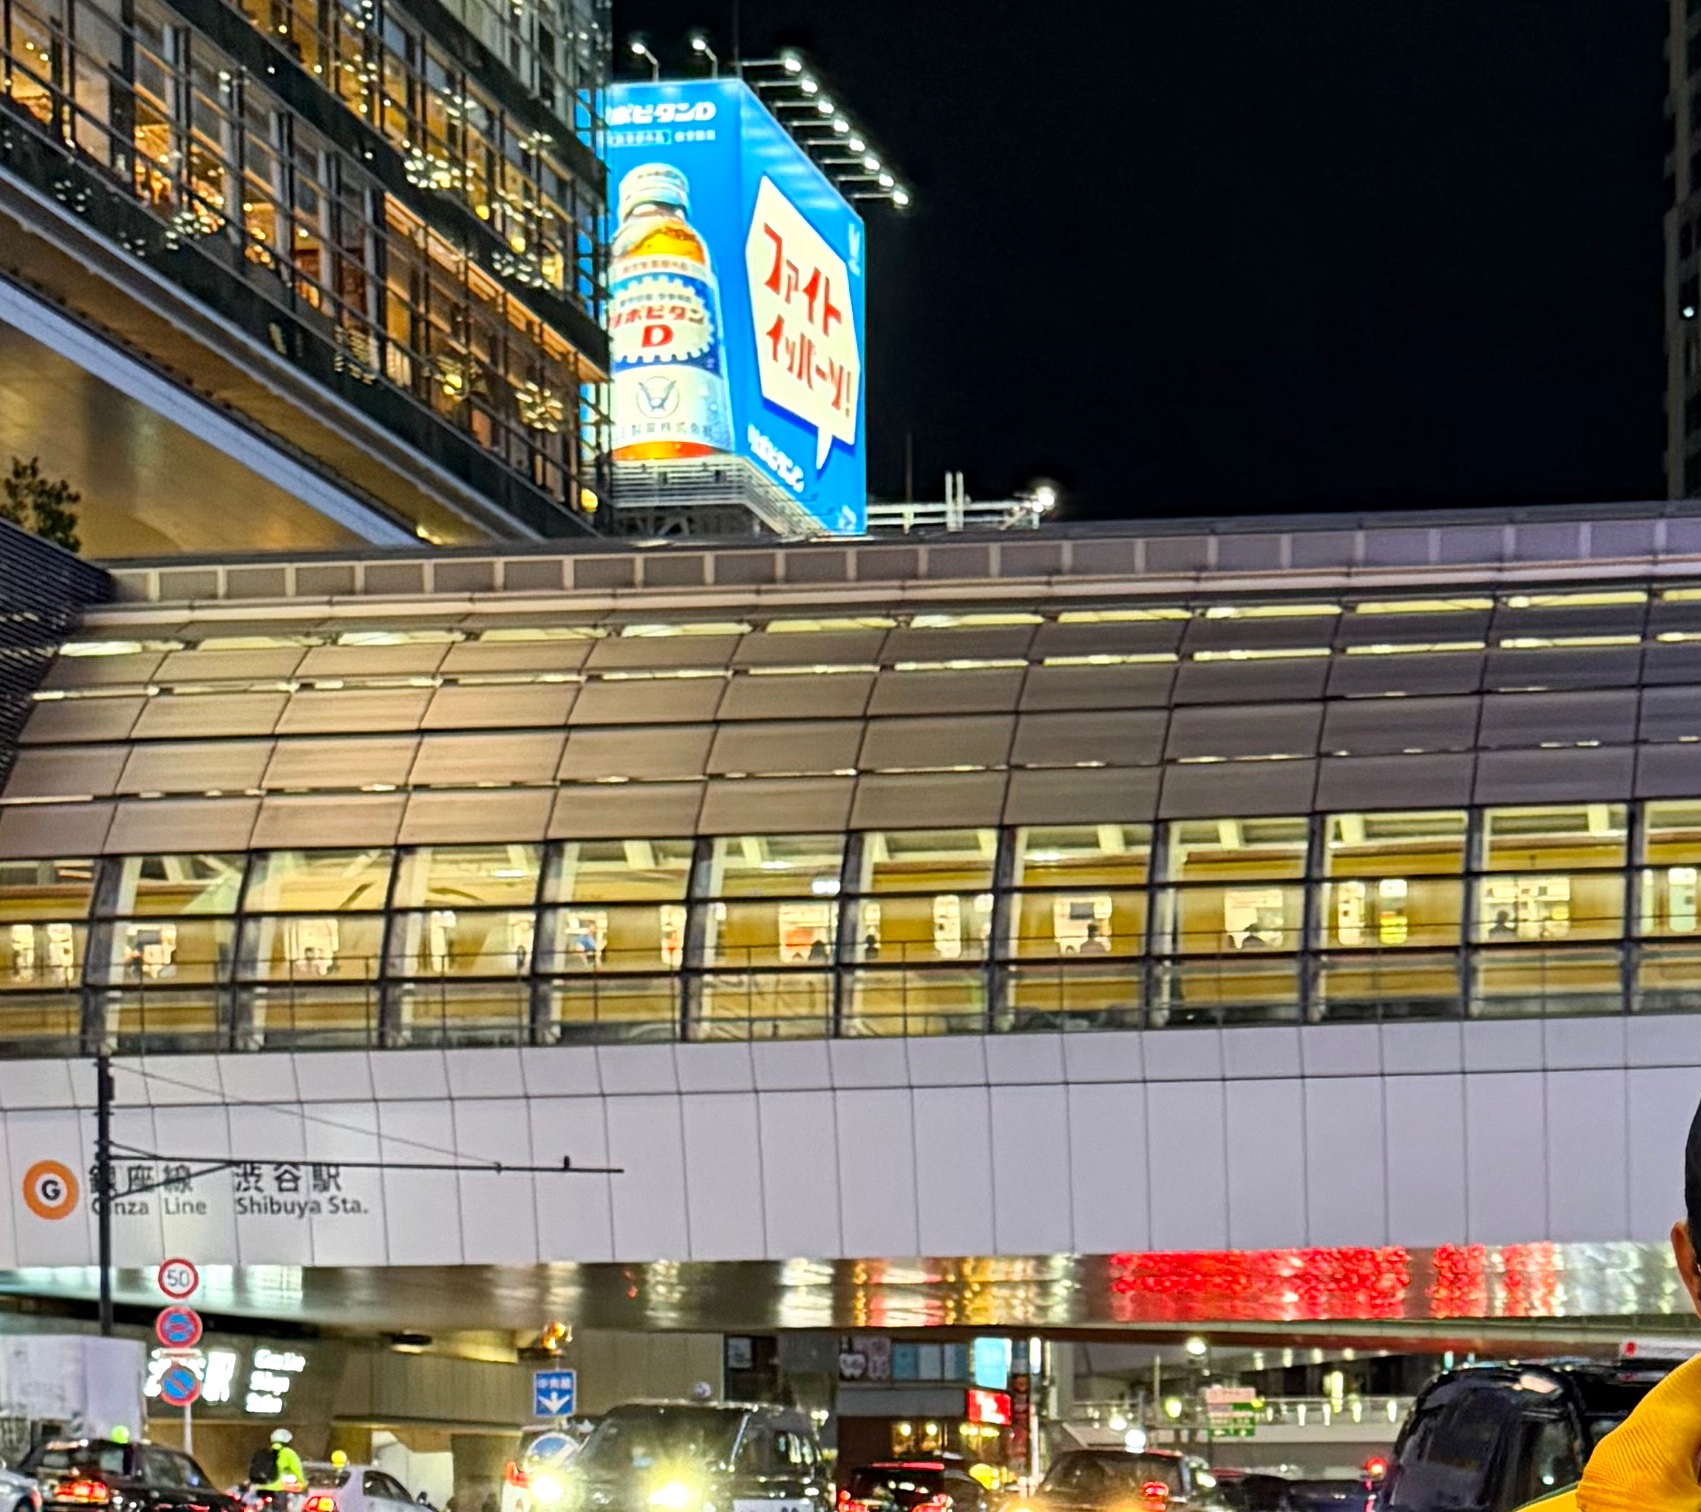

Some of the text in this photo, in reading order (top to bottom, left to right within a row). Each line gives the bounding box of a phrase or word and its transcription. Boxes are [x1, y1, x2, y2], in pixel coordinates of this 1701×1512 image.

[763, 222, 842, 337] ファイト
[641, 324, 674, 348] D
[41, 1178, 61, 1200] G
[234, 1162, 342, 1194] 渋谷駅
[91, 1198, 369, 1220] Gnza Line Shibuya Sta.
[166, 1269, 191, 1288] 50
